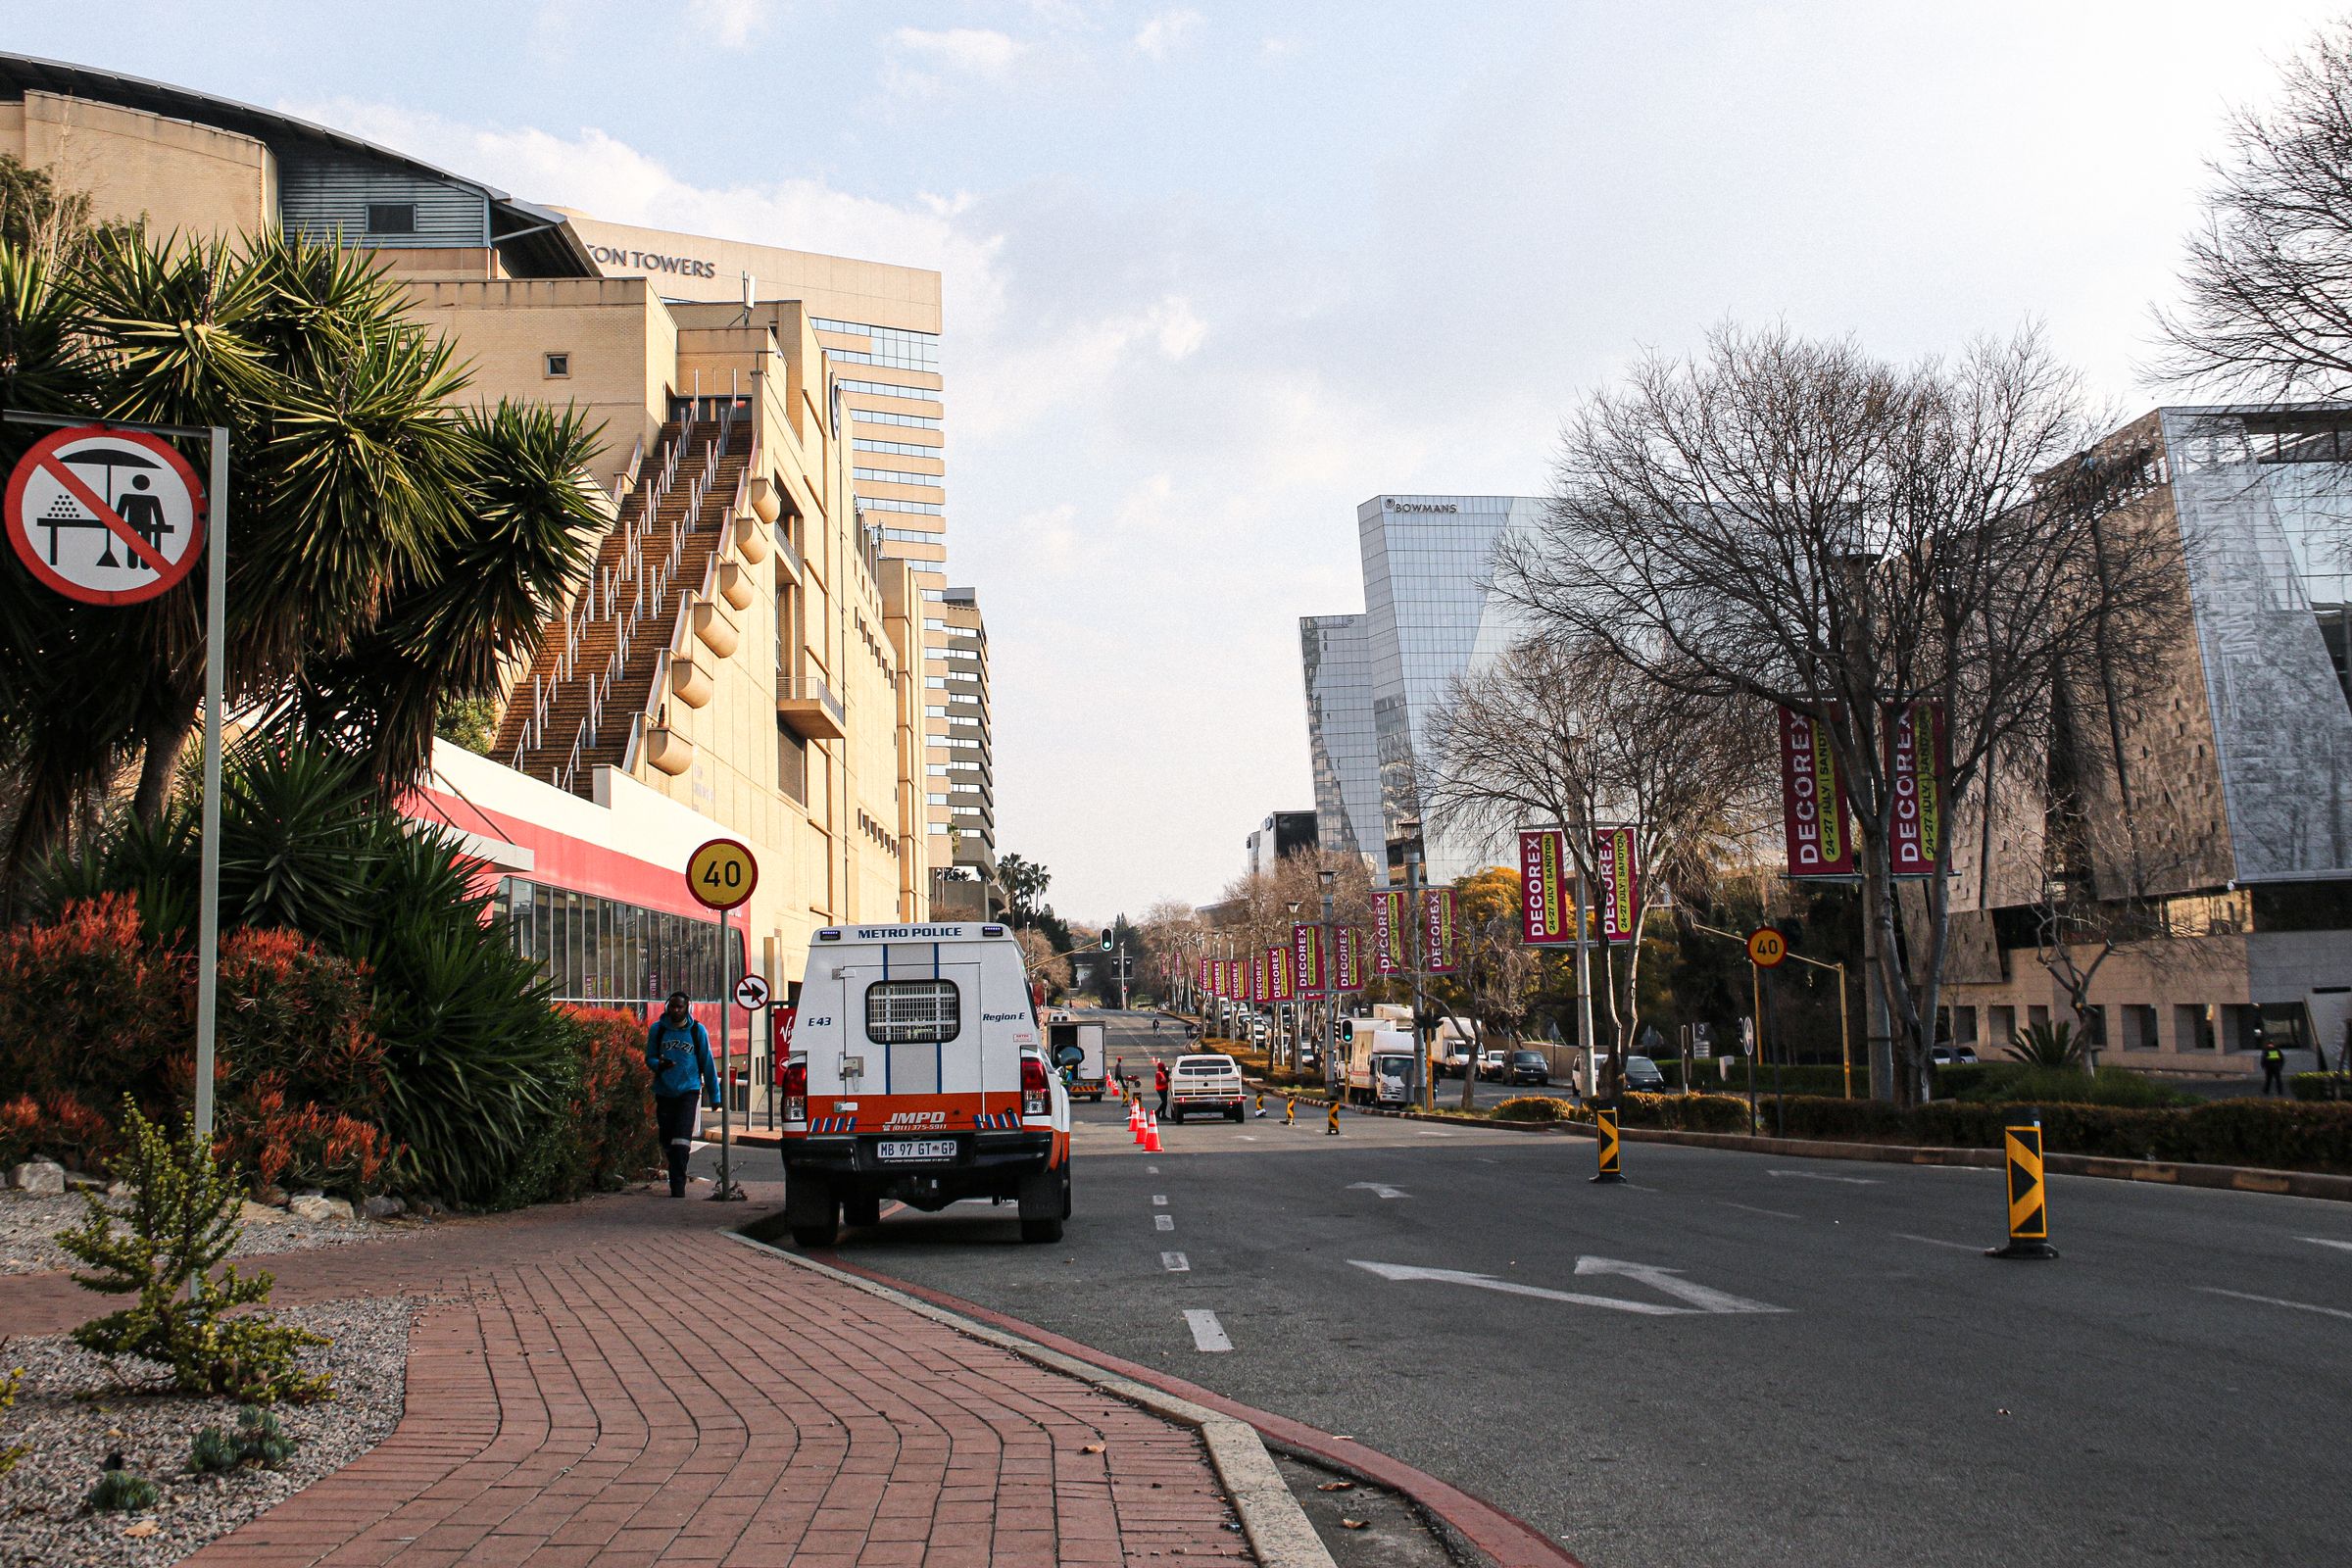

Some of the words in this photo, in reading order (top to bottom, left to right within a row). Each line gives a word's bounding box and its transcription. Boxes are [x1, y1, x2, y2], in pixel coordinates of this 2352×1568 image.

[630, 251, 715, 279] TOWERS
[1396, 504, 1457, 514] BOWMANS
[1790, 711, 1819, 863] DECOREX
[1821, 786, 1832, 815] JULY
[1922, 784, 1933, 815] JULY
[1824, 820, 1836, 856] 24-27
[1924, 818, 1935, 854] 24-27
[1544, 837, 1553, 879] SANDTON
[1617, 836, 1626, 877] SANDTON
[703, 860, 741, 888] 40
[1527, 837, 1544, 936] DECOREX
[858, 928, 908, 939] METRO
[911, 927, 962, 937] POLICE
[1430, 895, 1442, 967] DECOREX
[1298, 928, 1307, 987] DECOREX
[1340, 928, 1348, 986] DECOREX
[1757, 939, 1778, 956] 40
[1272, 950, 1281, 998] DECOREX
[808, 1017, 815, 1027] E
[816, 1016, 832, 1026] 43
[982, 1012, 1017, 1022] Region
[1698, 1023, 1705, 1035] 3
[884, 1111, 946, 1125] JMPD
[880, 1144, 895, 1156] MB
[900, 1143, 913, 1156] 97
[918, 1143, 932, 1155] GT
[941, 1142, 956, 1154] GP
